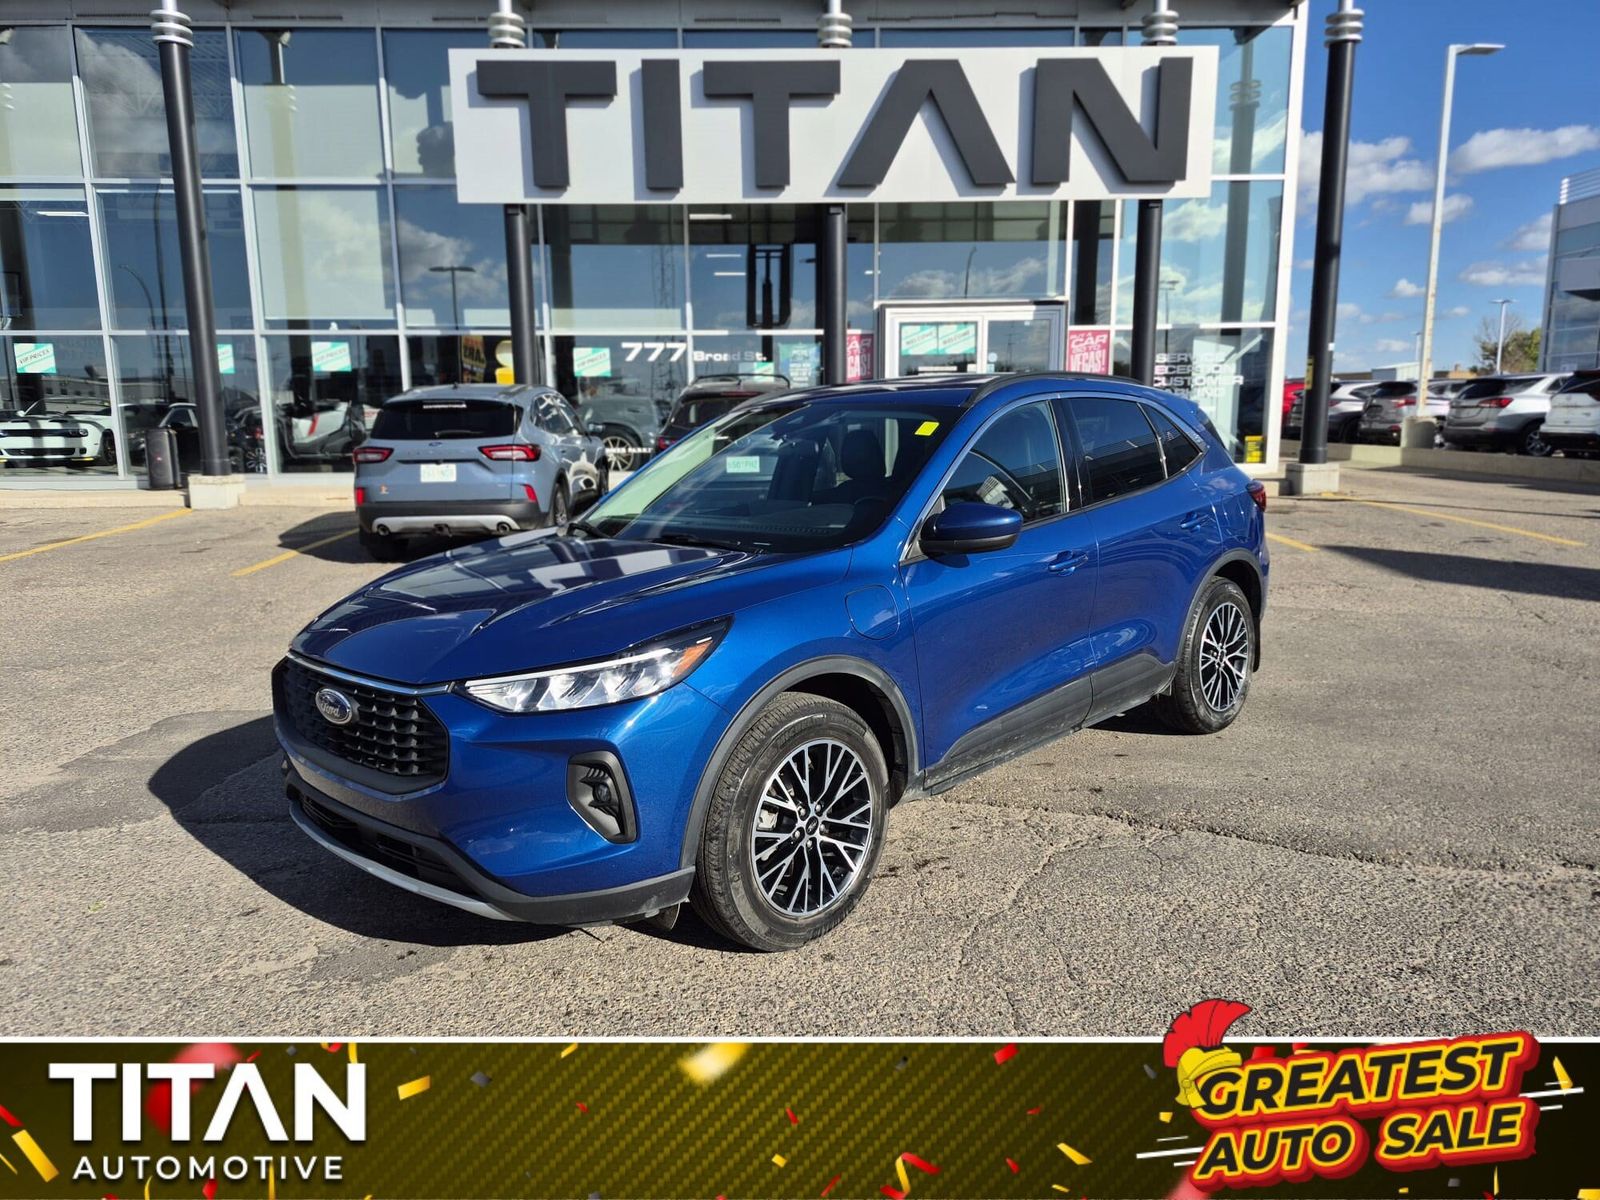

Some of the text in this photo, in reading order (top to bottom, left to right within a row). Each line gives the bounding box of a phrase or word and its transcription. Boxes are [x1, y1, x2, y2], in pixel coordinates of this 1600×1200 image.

[476, 57, 1193, 189] TITAN
[1070, 335, 1108, 348] CAR
[621, 342, 768, 362] 777 Broad St.
[1070, 349, 1107, 373] VEGAS!
[1154, 364, 1235, 375] ECEPTION
[1153, 376, 1244, 387] CUSTOMER
